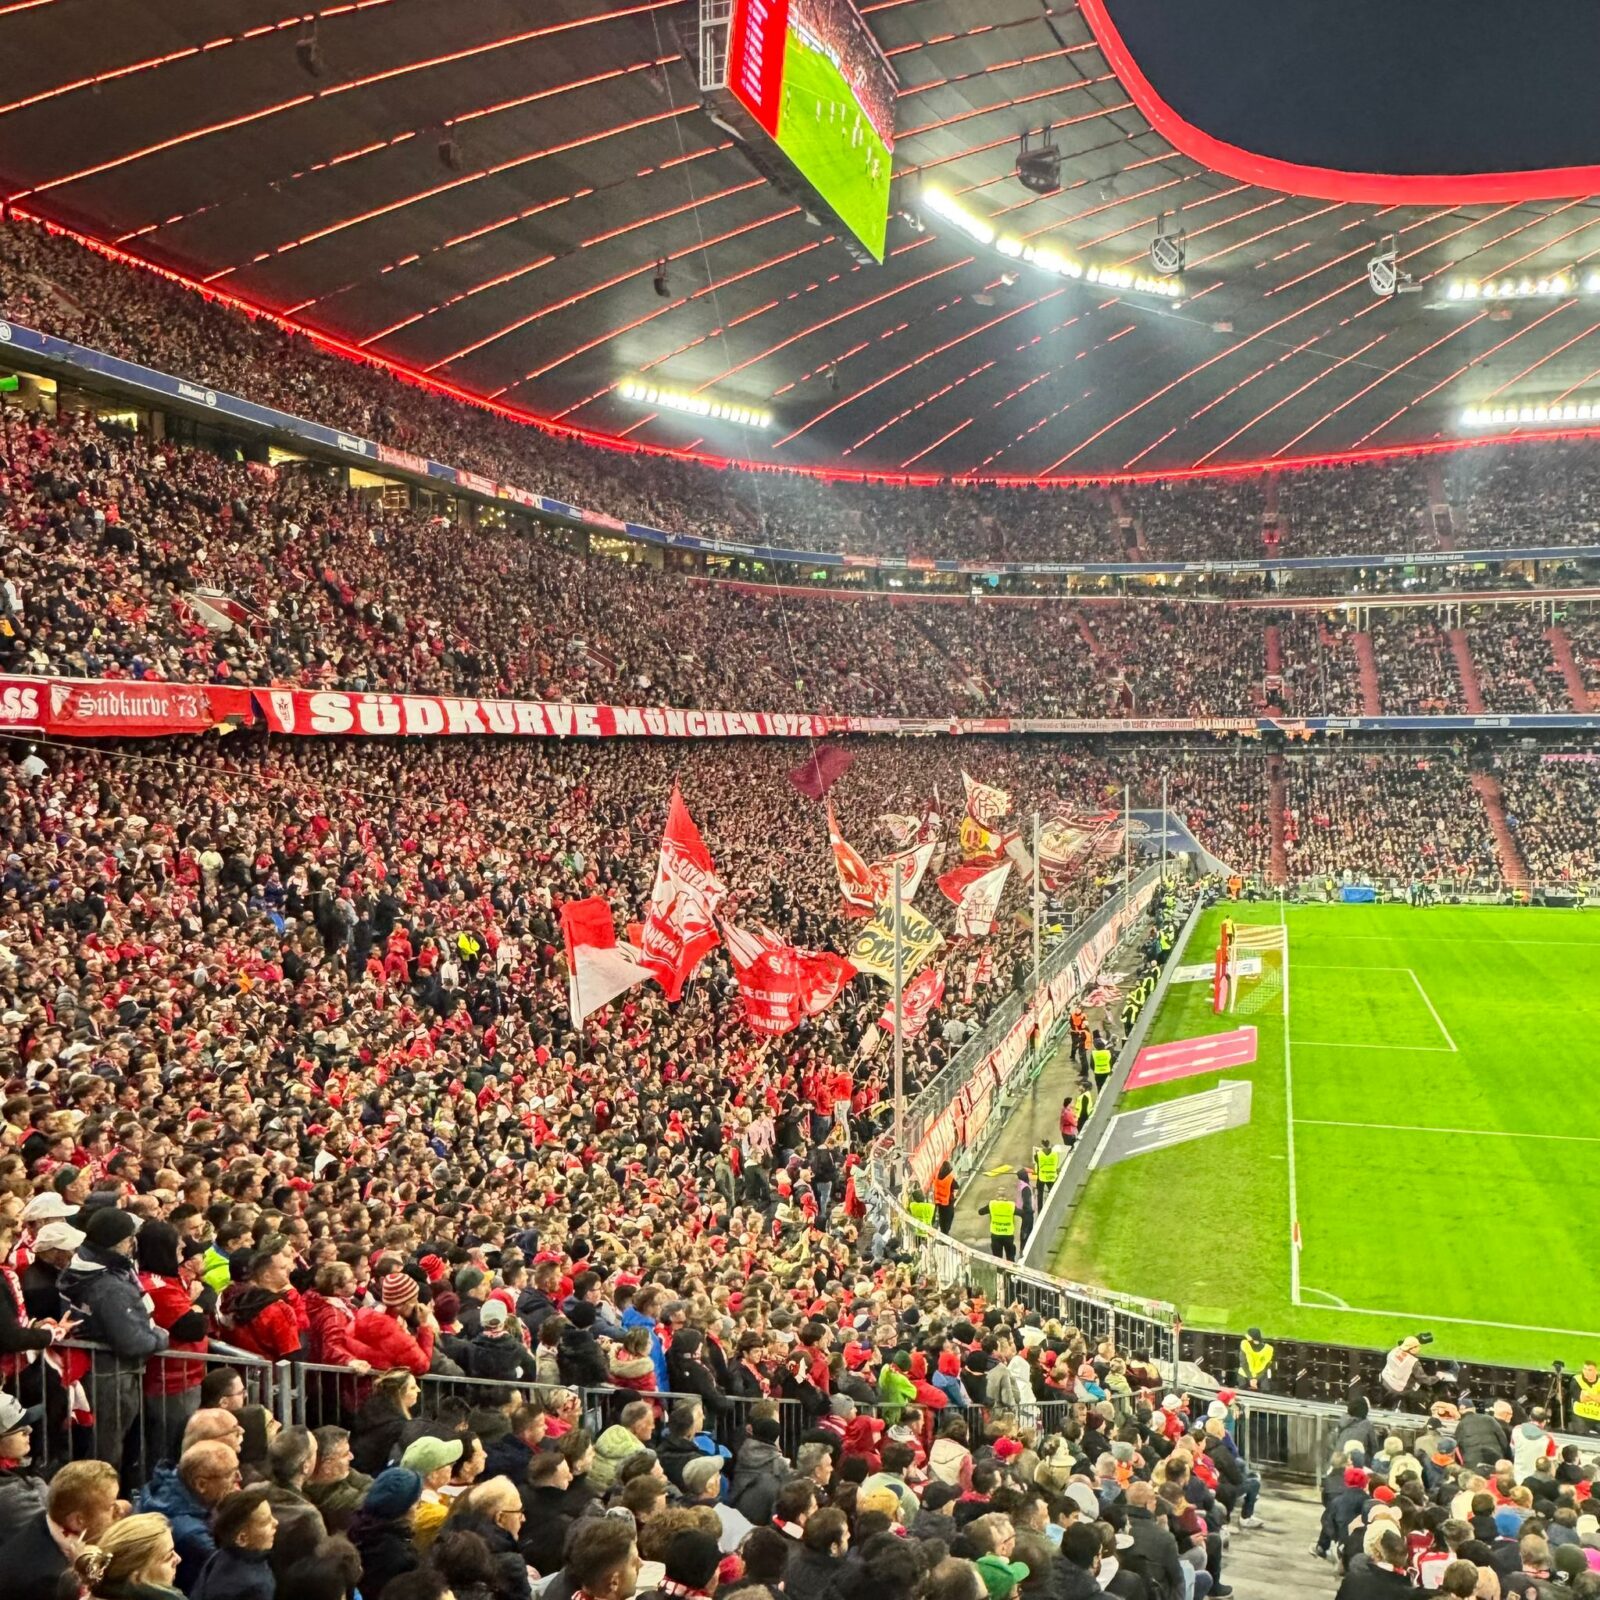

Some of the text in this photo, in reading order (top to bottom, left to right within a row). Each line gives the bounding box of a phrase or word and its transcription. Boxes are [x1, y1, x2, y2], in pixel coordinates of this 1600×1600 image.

[77, 689, 168, 717] Südkurve
[310, 691, 812, 736] SÜDKURVE MÜNCHEN 1972
[872, 903, 935, 943] MNGA
